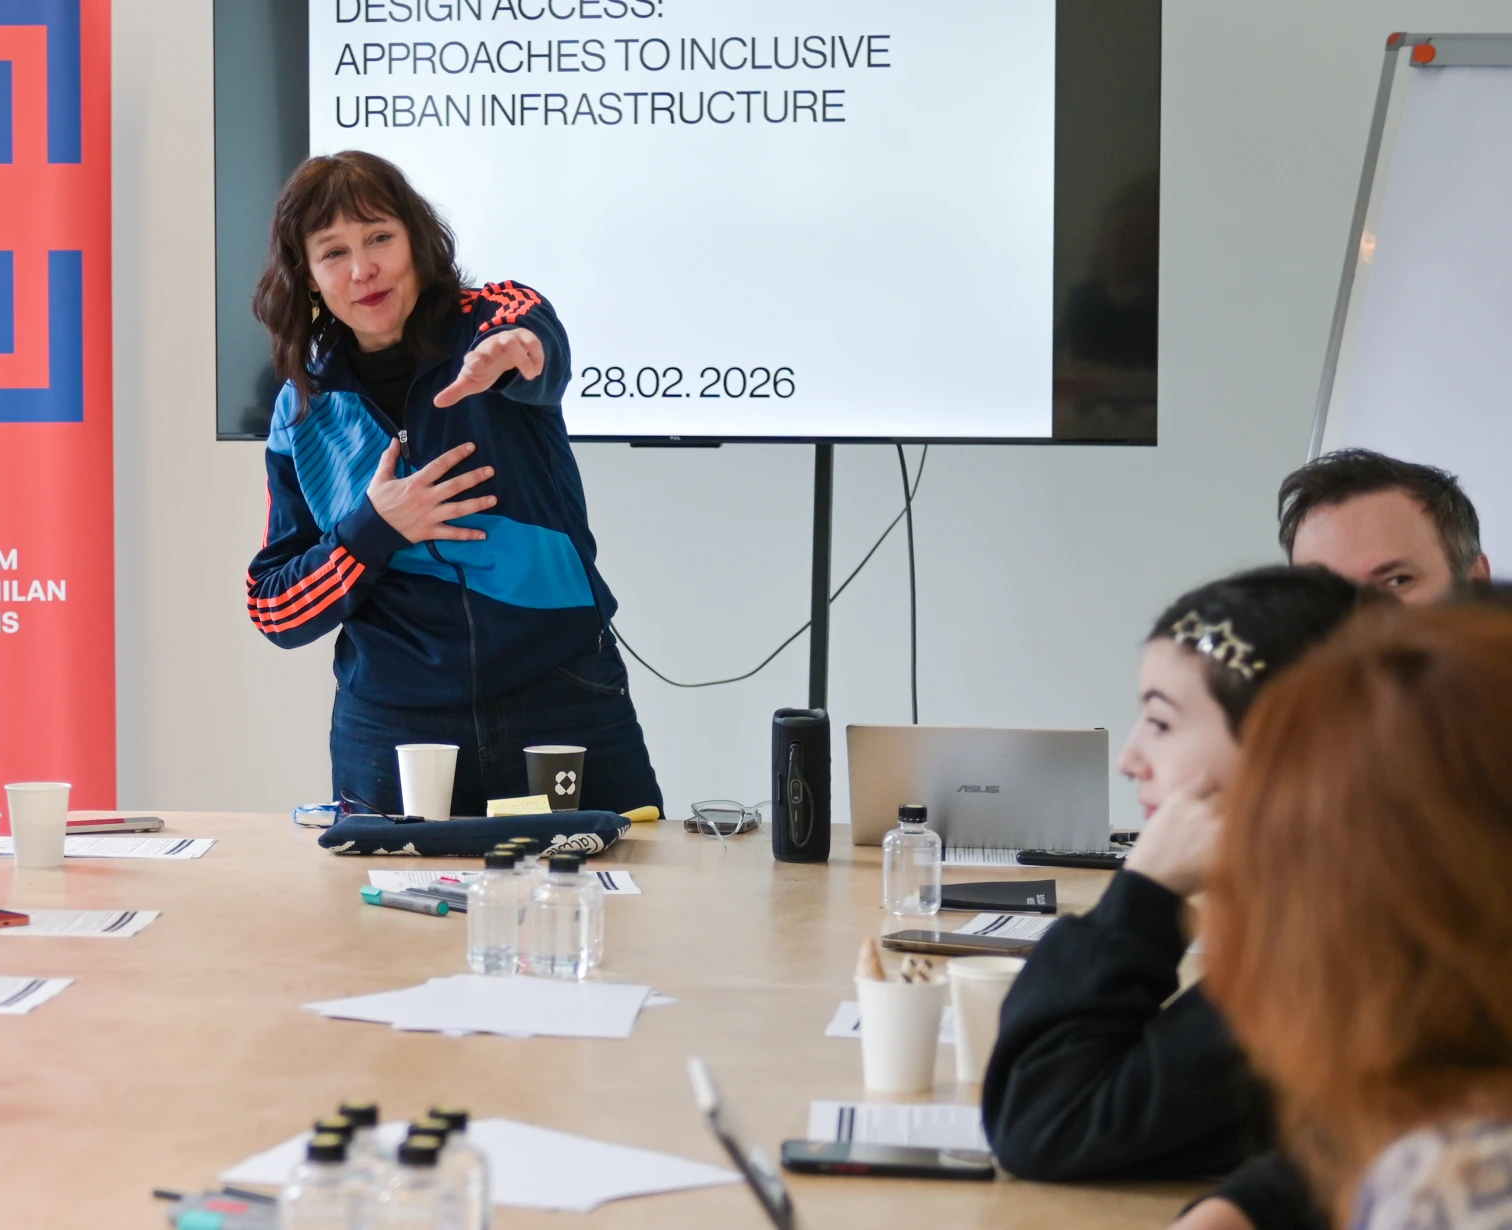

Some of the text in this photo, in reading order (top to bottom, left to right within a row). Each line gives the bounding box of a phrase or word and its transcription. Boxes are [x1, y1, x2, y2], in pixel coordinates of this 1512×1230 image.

[336, 0, 663, 24] DESIGN ACCESS:
[334, 34, 891, 76] APPROACHES TO INCLUSIVE
[336, 89, 846, 129] URBAN INFRASTRUCTURE
[580, 366, 796, 399] 28.02. 2026
[955, 784, 1001, 794] ASUS
